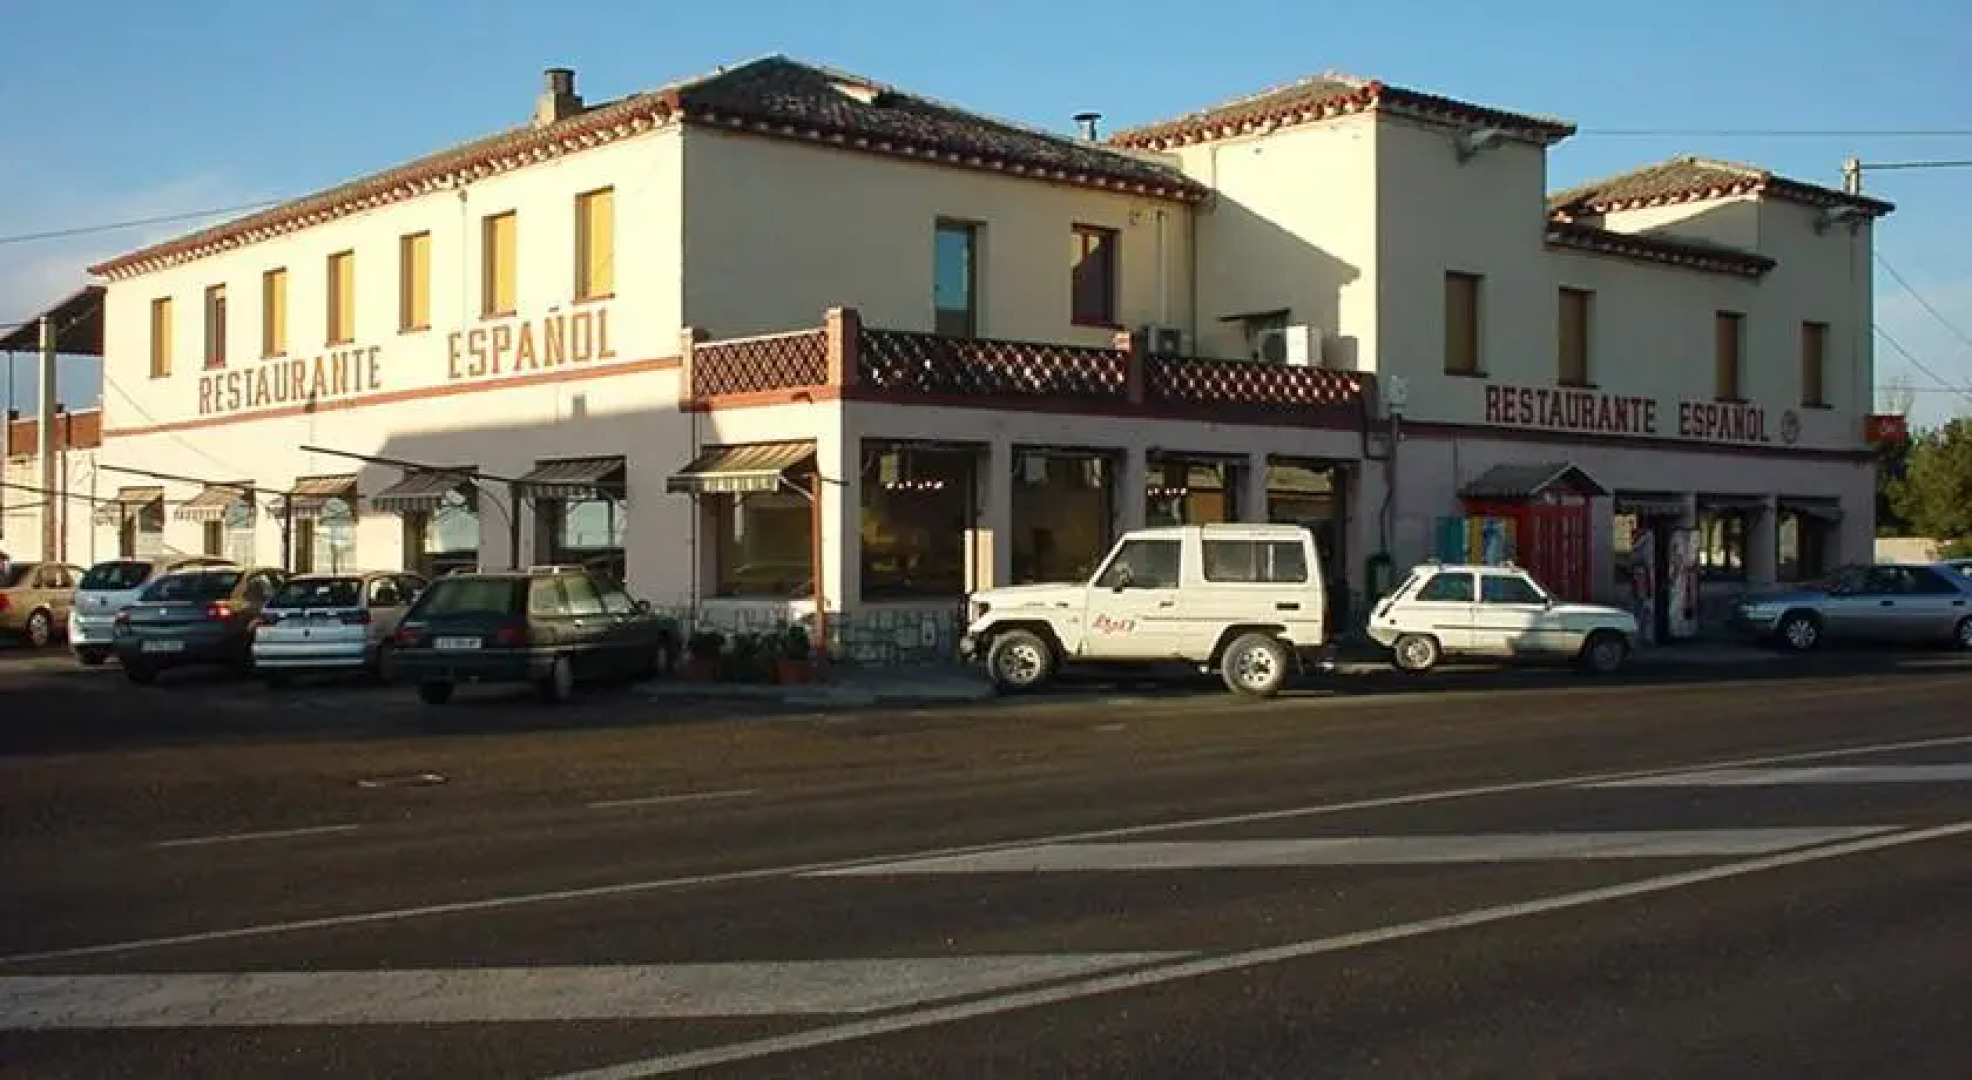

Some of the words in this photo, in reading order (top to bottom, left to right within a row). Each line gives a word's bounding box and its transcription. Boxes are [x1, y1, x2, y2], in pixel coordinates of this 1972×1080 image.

[199, 345, 381, 415] RESTAURANTE
[448, 305, 616, 378] ESPAÑOL
[1485, 385, 1656, 432] RESTAURANTE
